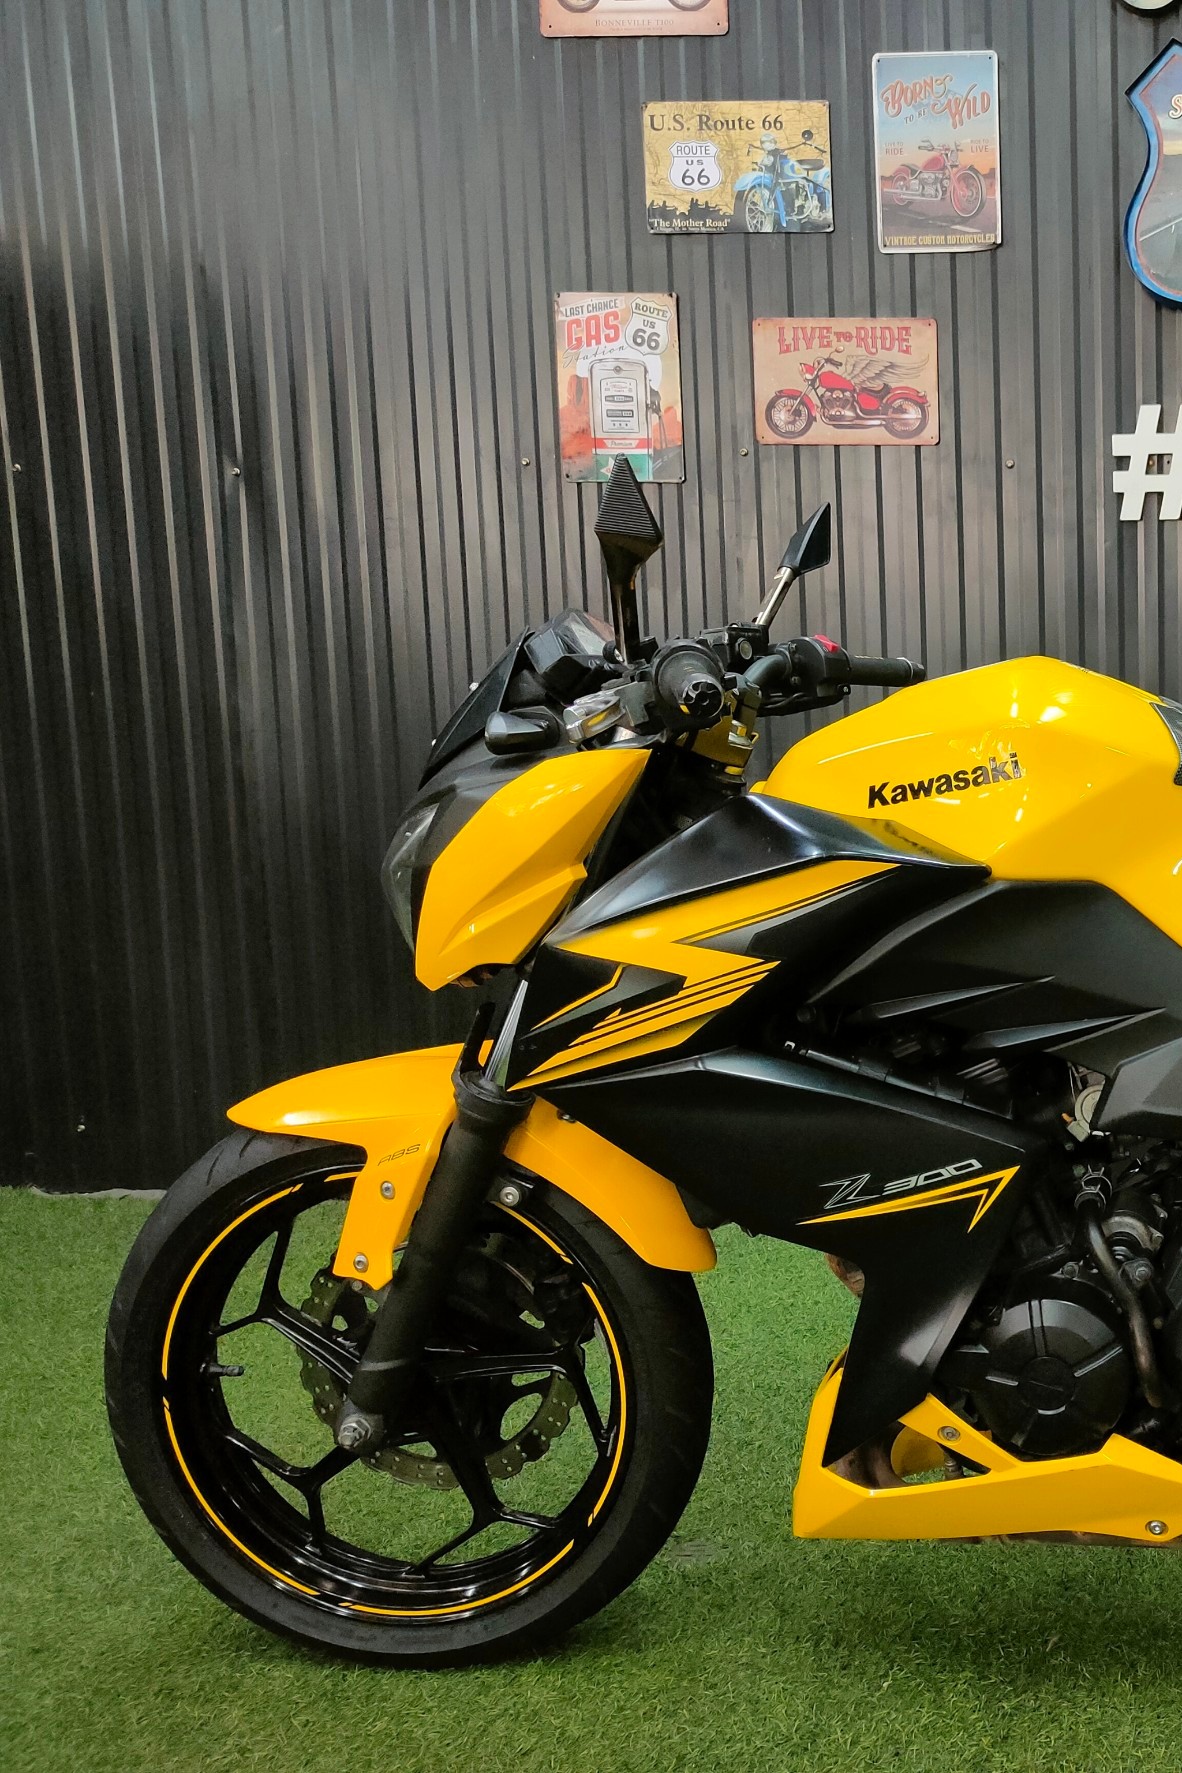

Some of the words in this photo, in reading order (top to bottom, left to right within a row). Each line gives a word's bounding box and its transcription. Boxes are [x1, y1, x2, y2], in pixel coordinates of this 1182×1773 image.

[880, 74, 953, 118] BORN
[904, 114, 914, 124] TO
[917, 107, 928, 119] BE
[931, 83, 991, 130] WILD
[648, 114, 691, 132] U.S.
[697, 113, 755, 131] Route
[761, 114, 784, 131] 66
[676, 145, 711, 156] ROUTE
[885, 147, 904, 156] RIDE
[970, 145, 989, 153] LIVE
[681, 168, 711, 187] 66
[672, 218, 704, 227] Mother
[884, 236, 917, 246] VINTAGE
[918, 235, 945, 245] CUSTOM
[947, 233, 995, 244] MOTORCYCLES
[564, 305, 584, 318] LAST
[586, 298, 619, 314] CHANCE
[634, 302, 669, 319] ROUTE
[566, 310, 621, 351] GAS
[642, 319, 657, 330] US
[632, 328, 661, 351] 66
[778, 326, 833, 355] LIVE
[834, 331, 853, 343] TO
[855, 326, 912, 356] RIDE
[563, 343, 629, 369] Station
[868, 752, 1022, 809] Kawasaki
[377, 1143, 421, 1167] ABS
